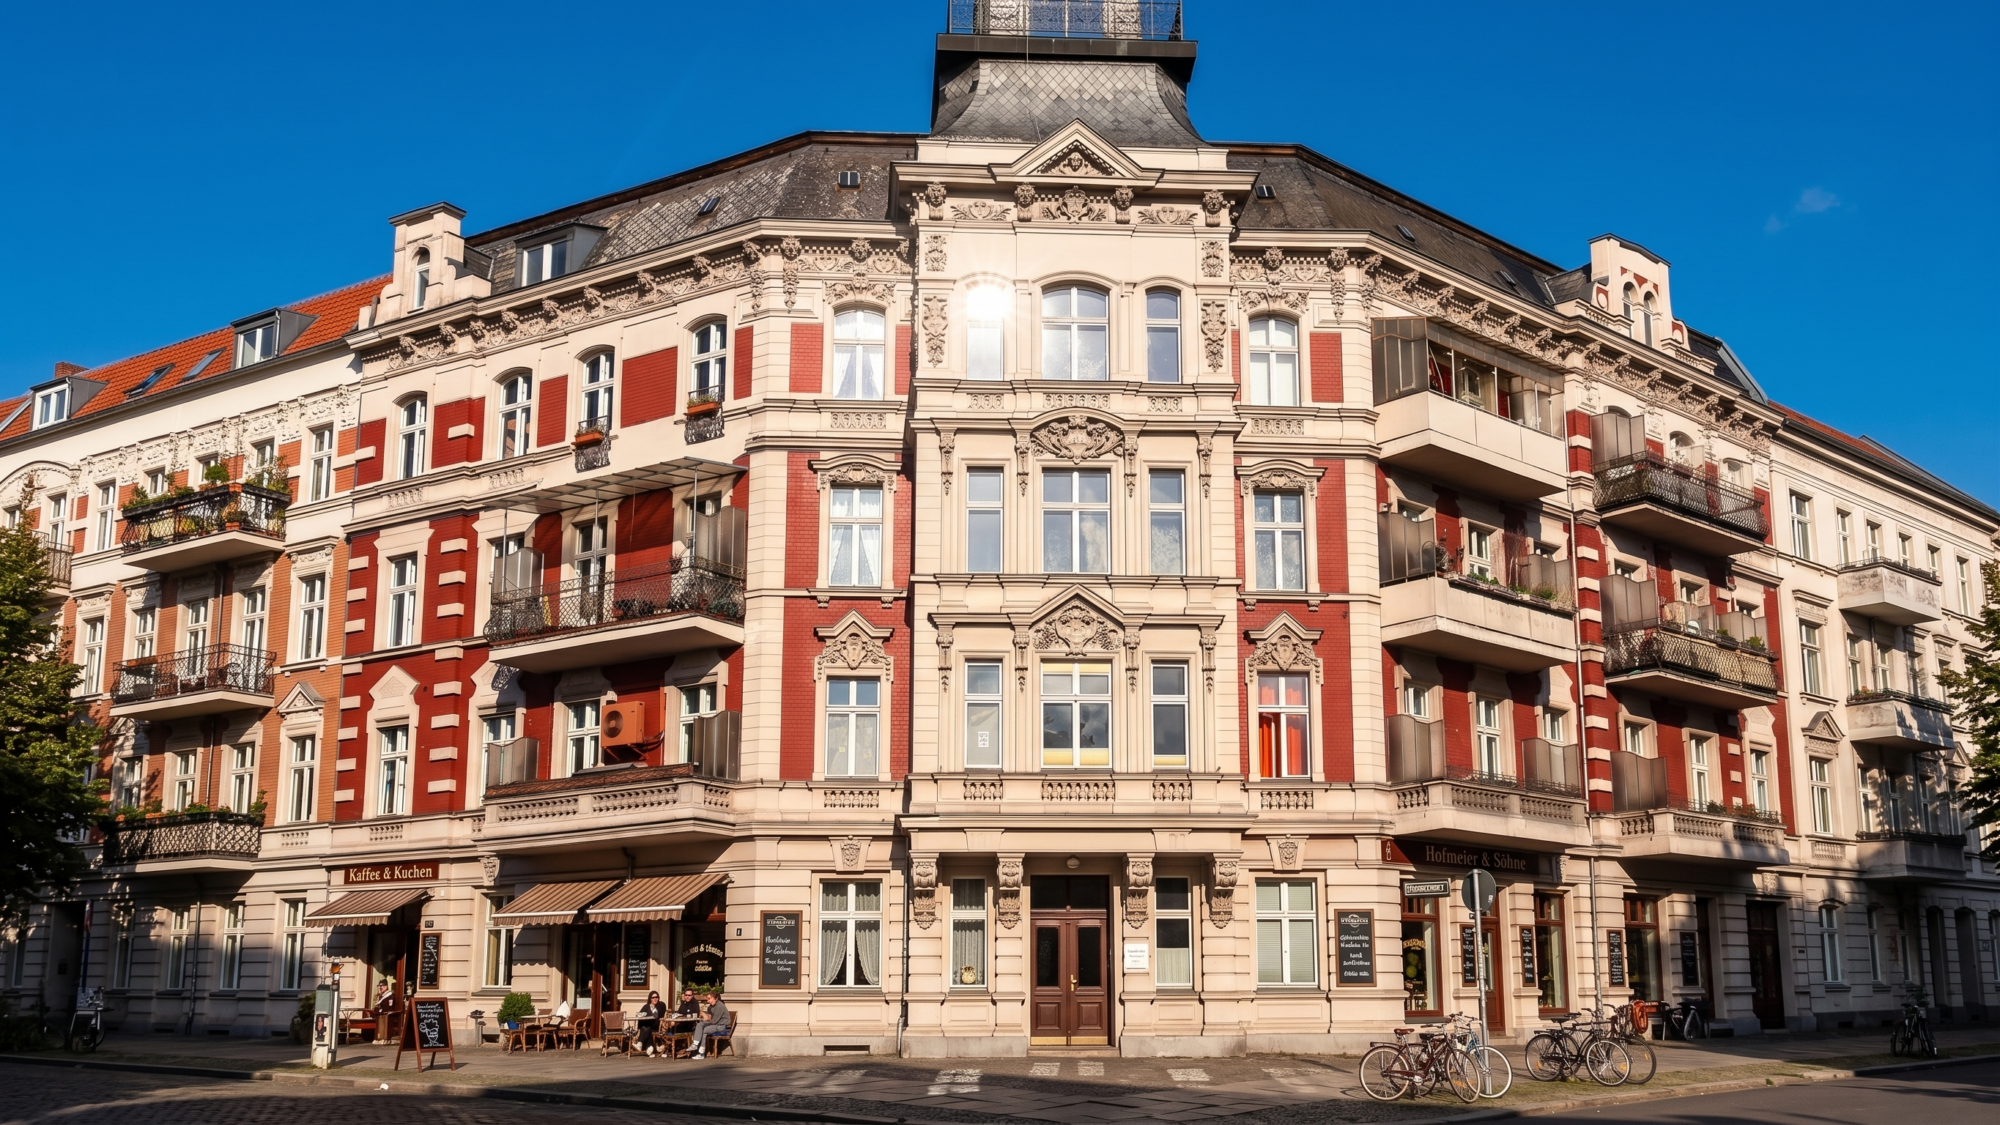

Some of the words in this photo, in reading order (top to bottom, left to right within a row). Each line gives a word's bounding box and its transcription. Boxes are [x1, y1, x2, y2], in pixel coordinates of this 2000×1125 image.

[1425, 845, 1478, 866] Hofmeier
[1481, 852, 1491, 867] &
[1494, 852, 1526, 870] Söhne
[383, 867, 392, 880] &
[394, 865, 433, 879] Kuchen
